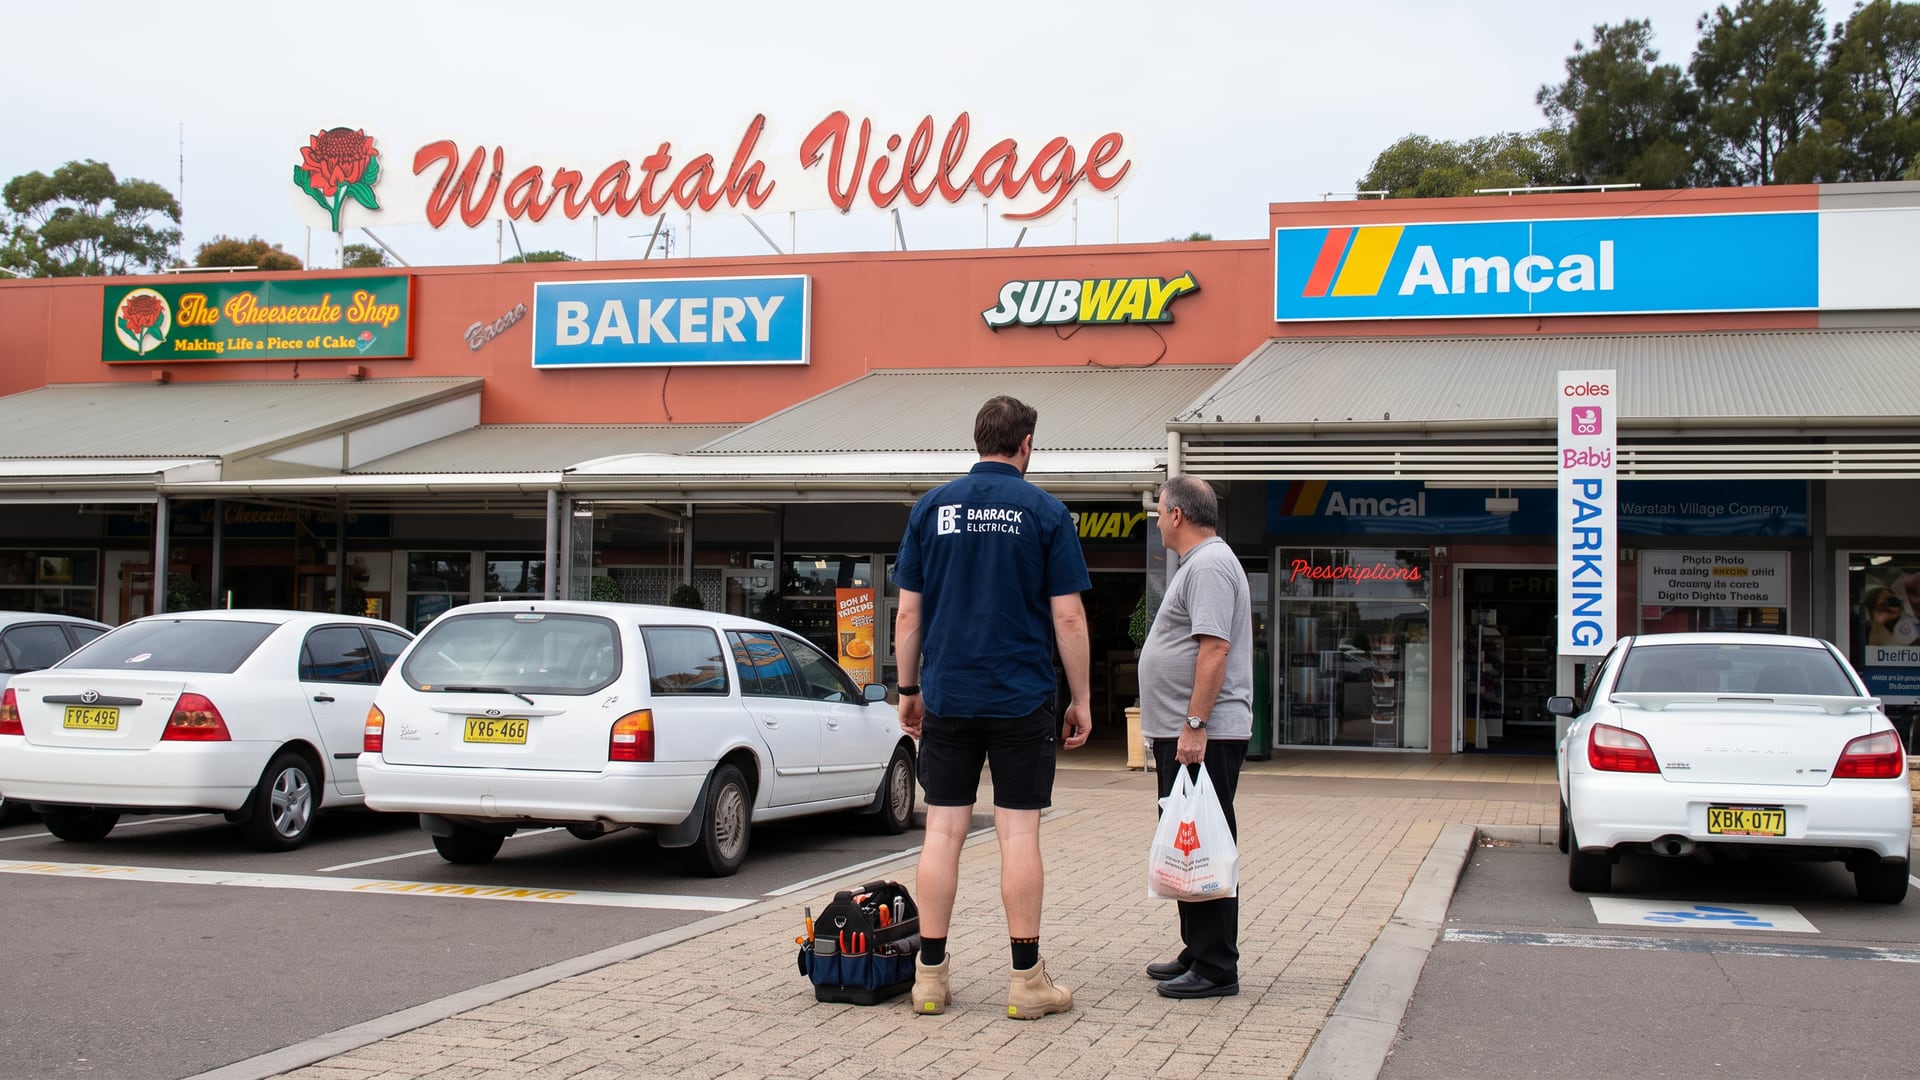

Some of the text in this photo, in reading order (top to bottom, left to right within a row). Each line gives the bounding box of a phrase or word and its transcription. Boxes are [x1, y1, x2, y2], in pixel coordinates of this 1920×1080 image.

[413, 110, 1132, 229] Waratah Village
[1398, 240, 1614, 295] Amcal
[176, 290, 400, 328] The Cheesecake Shop
[982, 273, 1195, 326] SUBWAY
[556, 296, 785, 346] BAKERY
[174, 336, 356, 353] Making Life a Piece of Cake
[1564, 381, 1610, 397] coles
[1562, 446, 1611, 469] Baby
[966, 508, 1023, 524] BARRACK
[1325, 491, 1426, 517] Amcal
[1621, 502, 1676, 515] Waratah
[1680, 502, 1725, 517] Village
[1572, 478, 1604, 647] PARKING
[1715, 555, 1745, 564] Photo
